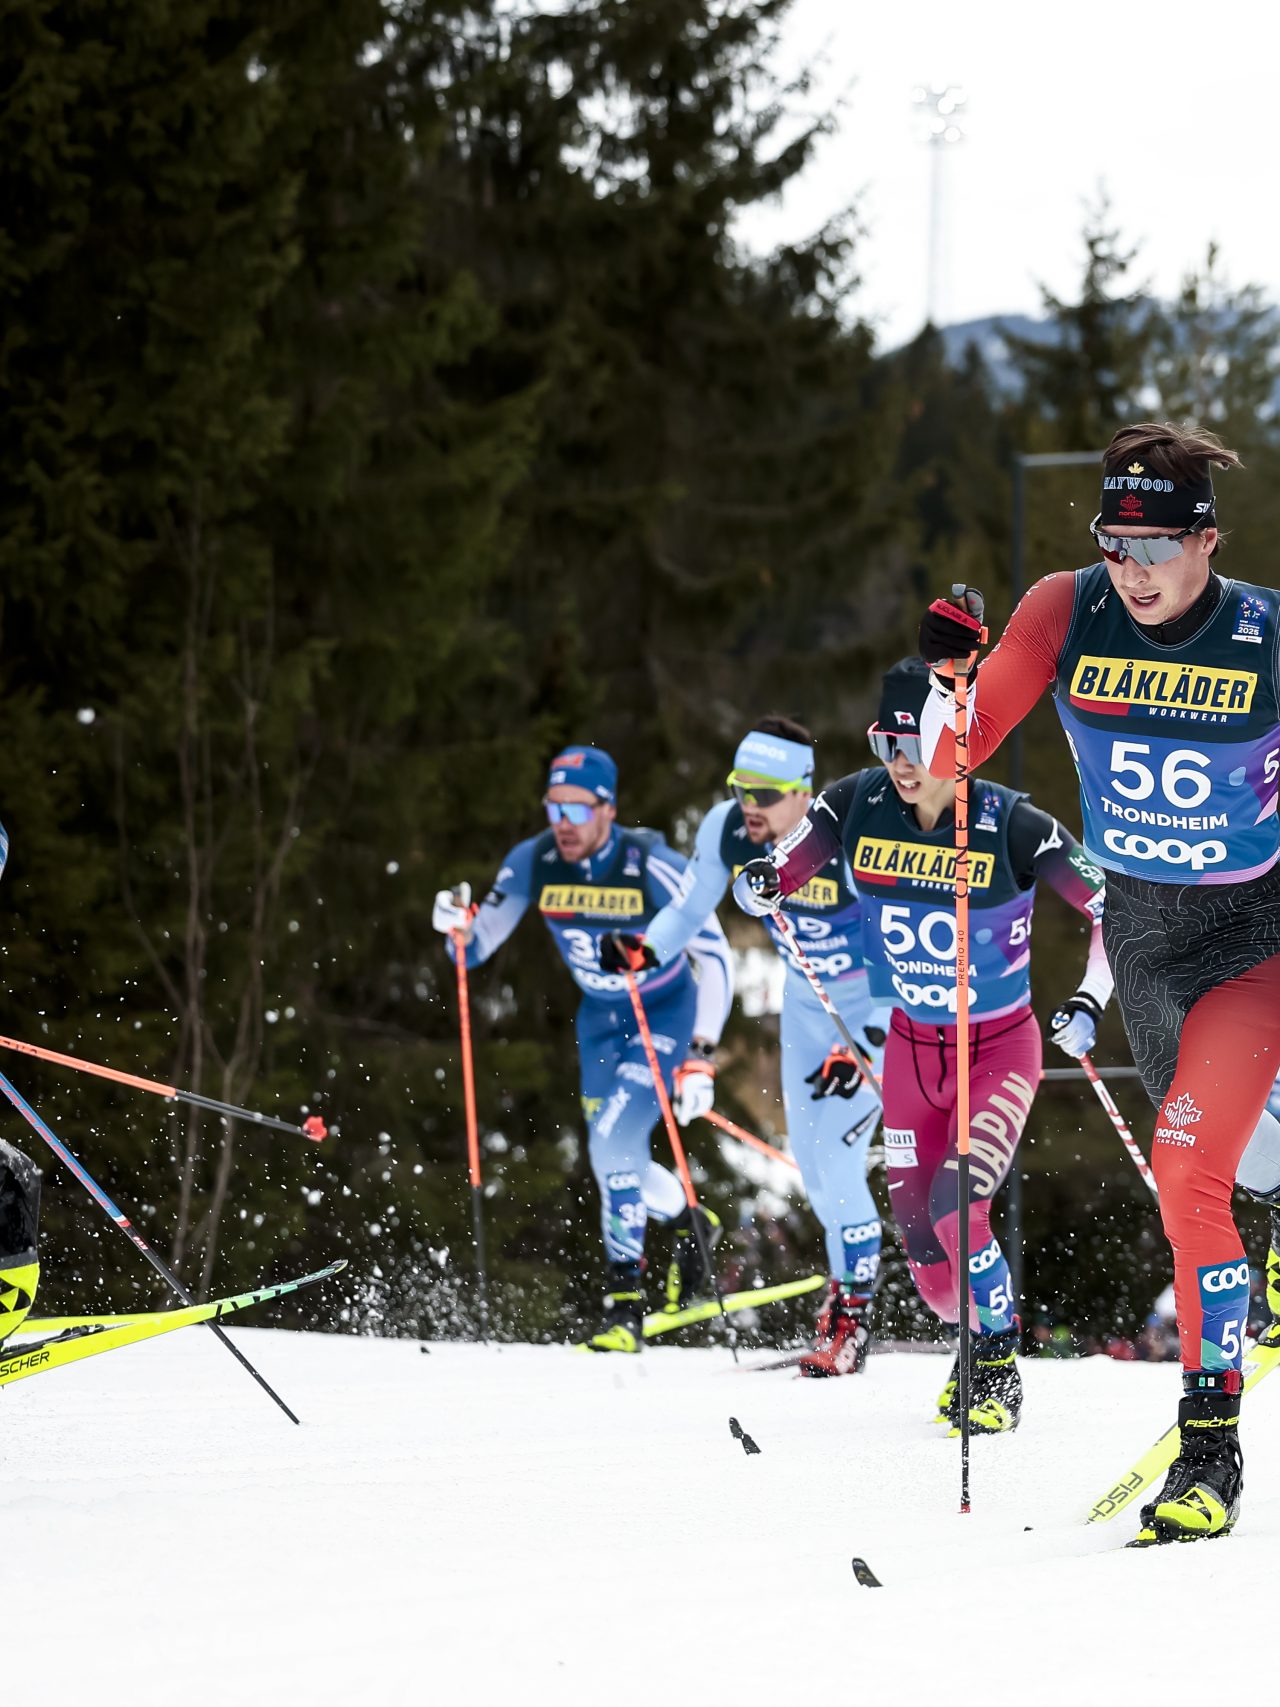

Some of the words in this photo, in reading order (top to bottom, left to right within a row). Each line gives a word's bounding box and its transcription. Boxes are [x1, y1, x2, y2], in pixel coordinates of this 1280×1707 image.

[1237, 626, 1260, 635] 2025
[1077, 661, 1249, 710] BLÅKLÄDER
[1148, 707, 1228, 723] WORKWEAR
[1110, 740, 1213, 810] 56
[1101, 796, 1229, 831] TRONDHEIM
[859, 843, 988, 884] BLÅKLÄDR
[881, 904, 957, 962] 50
[958, 929, 965, 943] 40
[958, 948, 966, 986] PREMIO
[944, 1071, 1035, 1197] JAPAN
[1156, 1128, 1196, 1147] nordiq
[1157, 1138, 1187, 1148] CANADA
